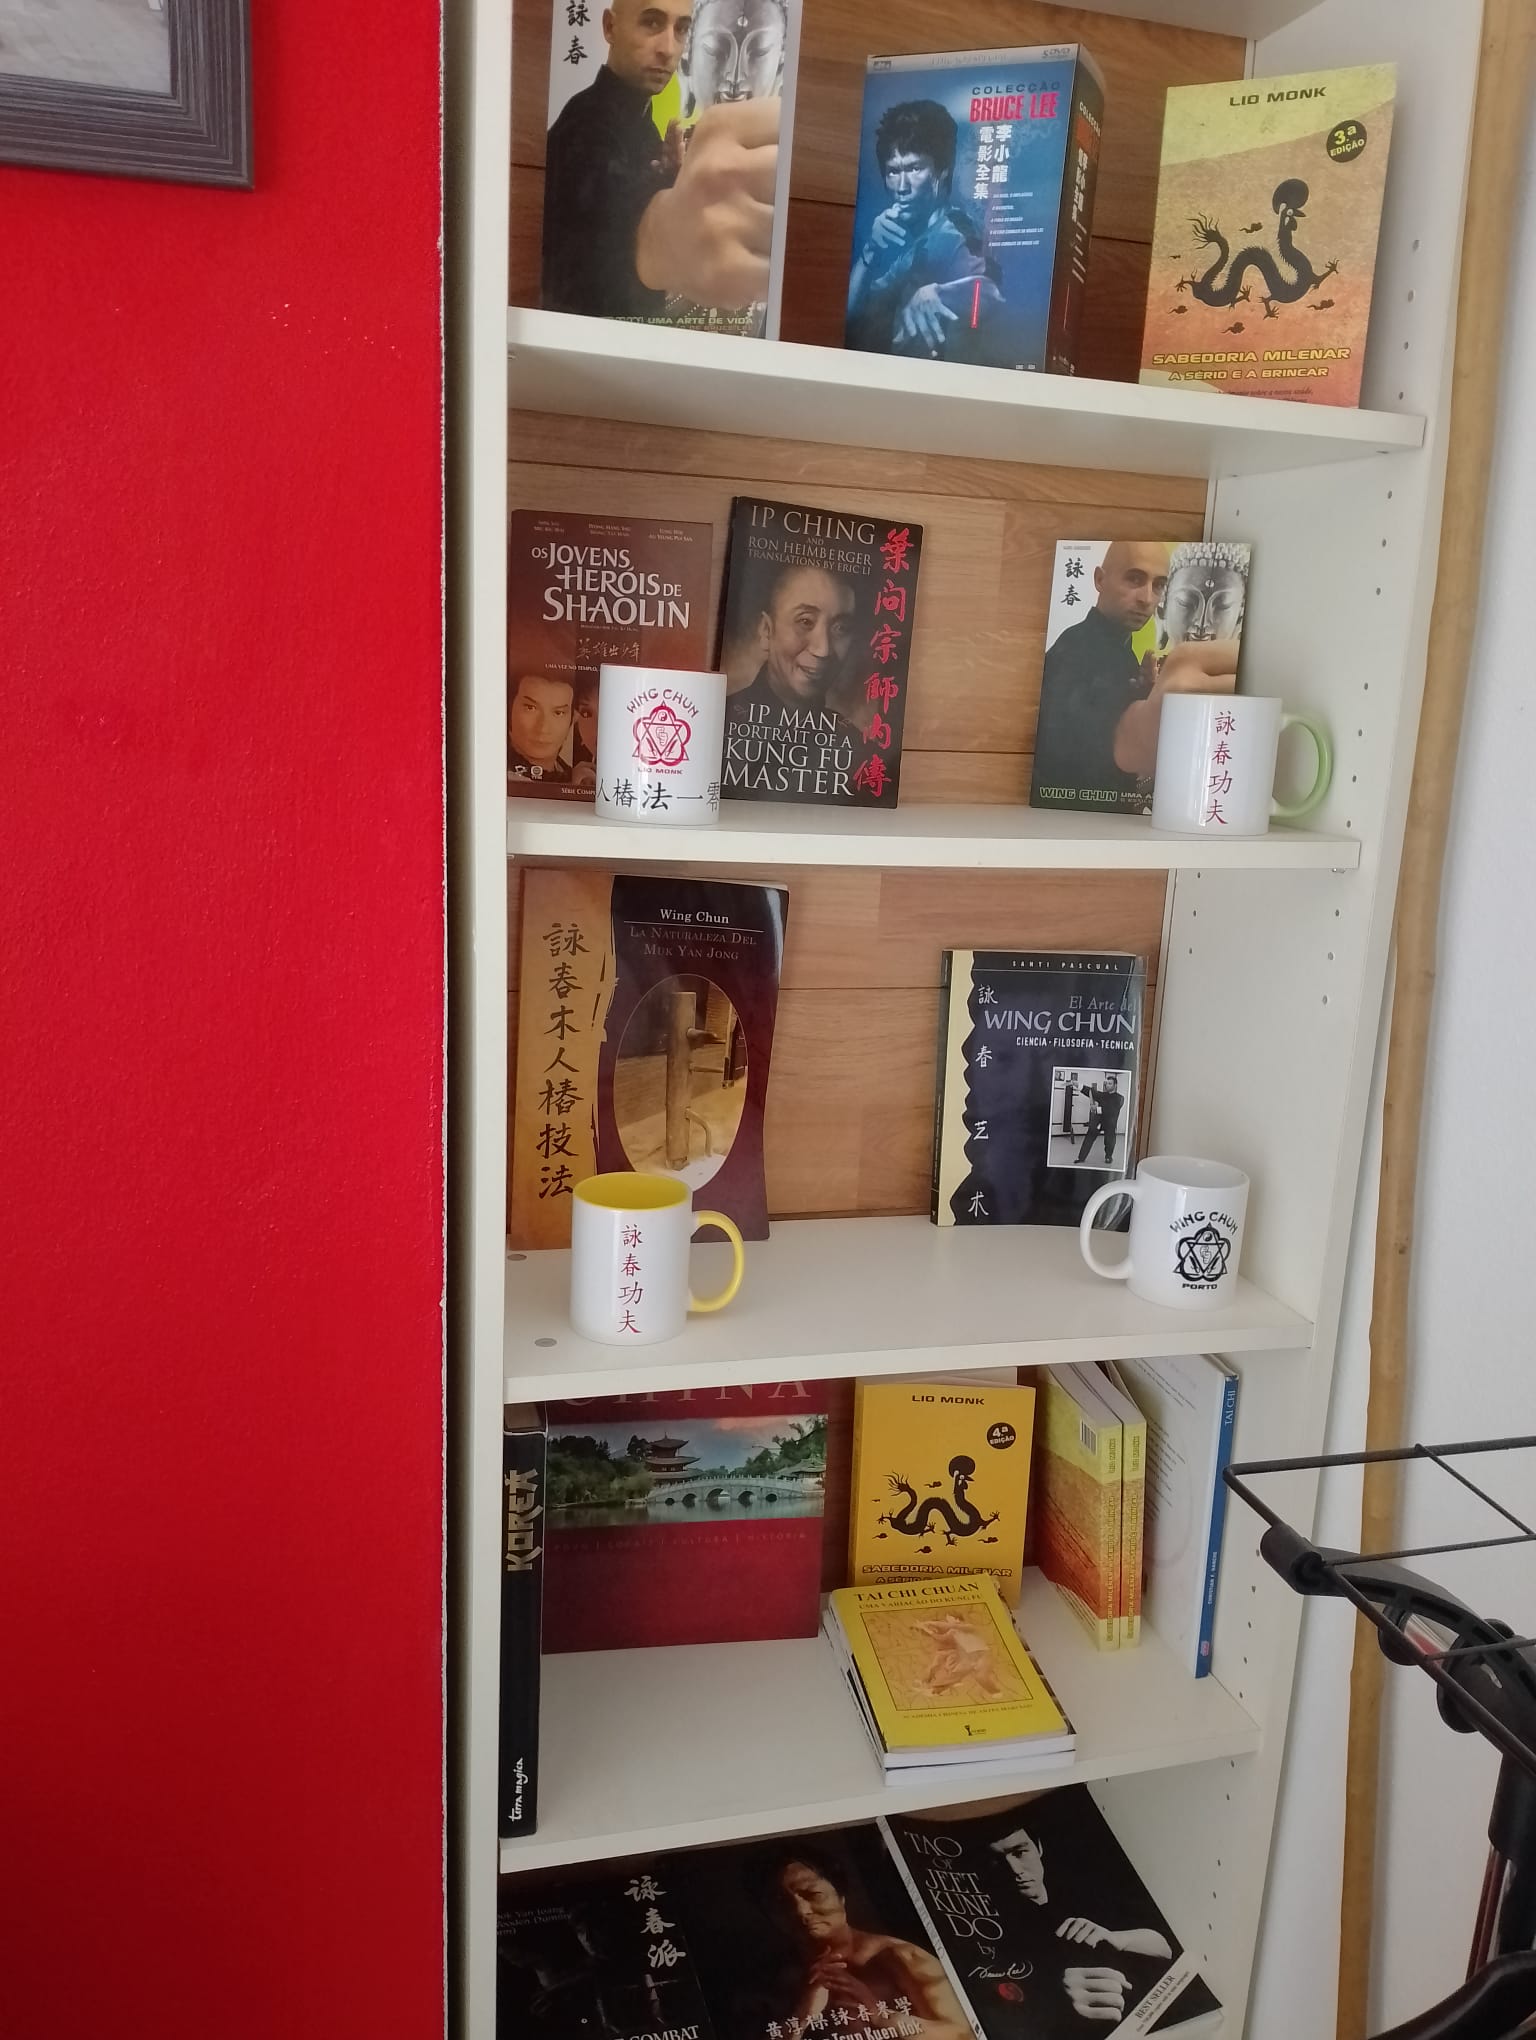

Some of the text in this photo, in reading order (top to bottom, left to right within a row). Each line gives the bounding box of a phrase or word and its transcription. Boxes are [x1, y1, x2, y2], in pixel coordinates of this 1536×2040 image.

[972, 81, 1061, 96] COLECÇÃO
[1229, 86, 1328, 107] LIO MONK
[969, 92, 1060, 123] BRUCE LEE
[991, 124, 1012, 184] 李小龍
[1330, 138, 1365, 157] EDIÇÃO
[973, 126, 995, 200] 電影全集
[648, 317, 673, 325] UMA
[677, 317, 704, 325] ARTE
[709, 317, 723, 325] DE
[727, 317, 753, 325] VIDA
[1152, 348, 1351, 365] SABEDORIA MILENAR
[1168, 367, 1330, 382] A SÉRIO E A BRINCAR
[751, 505, 876, 545] IP CHING
[748, 535, 872, 566] RON HEIMBERGER
[806, 537, 824, 546] AND
[532, 542, 631, 569] OS JOVENS
[748, 549, 871, 576] TRANSLATIONS BY ERIC LI
[555, 566, 682, 597] HERÓIS DE
[1060, 557, 1085, 607] 詠春
[543, 587, 690, 630] SHAOLIN
[627, 688, 699, 718] WING CHUN
[748, 703, 838, 732] IP MAN
[728, 722, 852, 748] PORTRAIT OF A
[726, 737, 853, 771] KUNG FU
[723, 760, 855, 797] MASTER
[1204, 710, 1236, 825] 詠春功夫
[1040, 787, 1076, 799] WING
[1079, 789, 1118, 802] CHUN
[660, 908, 729, 924] Wing Chun
[1012, 960, 1119, 971] SANTI PASCUAL
[1069, 995, 1082, 1010] El
[1087, 997, 1116, 1011] Arte
[984, 1010, 1137, 1034] WING CHUN
[1016, 1036, 1047, 1047] CIENCIA
[1169, 1211, 1239, 1235] WING CHUN
[616, 1224, 643, 1334] 詠春功夫
[911, 1394, 985, 1406] LIO MONK
[1225, 1390, 1236, 1427] TAI CHI
[505, 1469, 543, 1572] KOREA
[862, 1564, 944, 1574] SABEDORIA
[875, 1576, 886, 1584] A
[854, 1581, 980, 1602] TAI CHI CHUAN
[904, 1831, 962, 1857] TAO
[925, 1869, 982, 1894] JEET
[928, 1889, 1000, 1916] KUNE
[945, 1913, 1004, 1940] DO
[977, 1942, 996, 1960] by
[1134, 1975, 1175, 2018] BEST SELLER
[864, 2026, 898, 2040] Kuen
[898, 2020, 923, 2037] Hok
